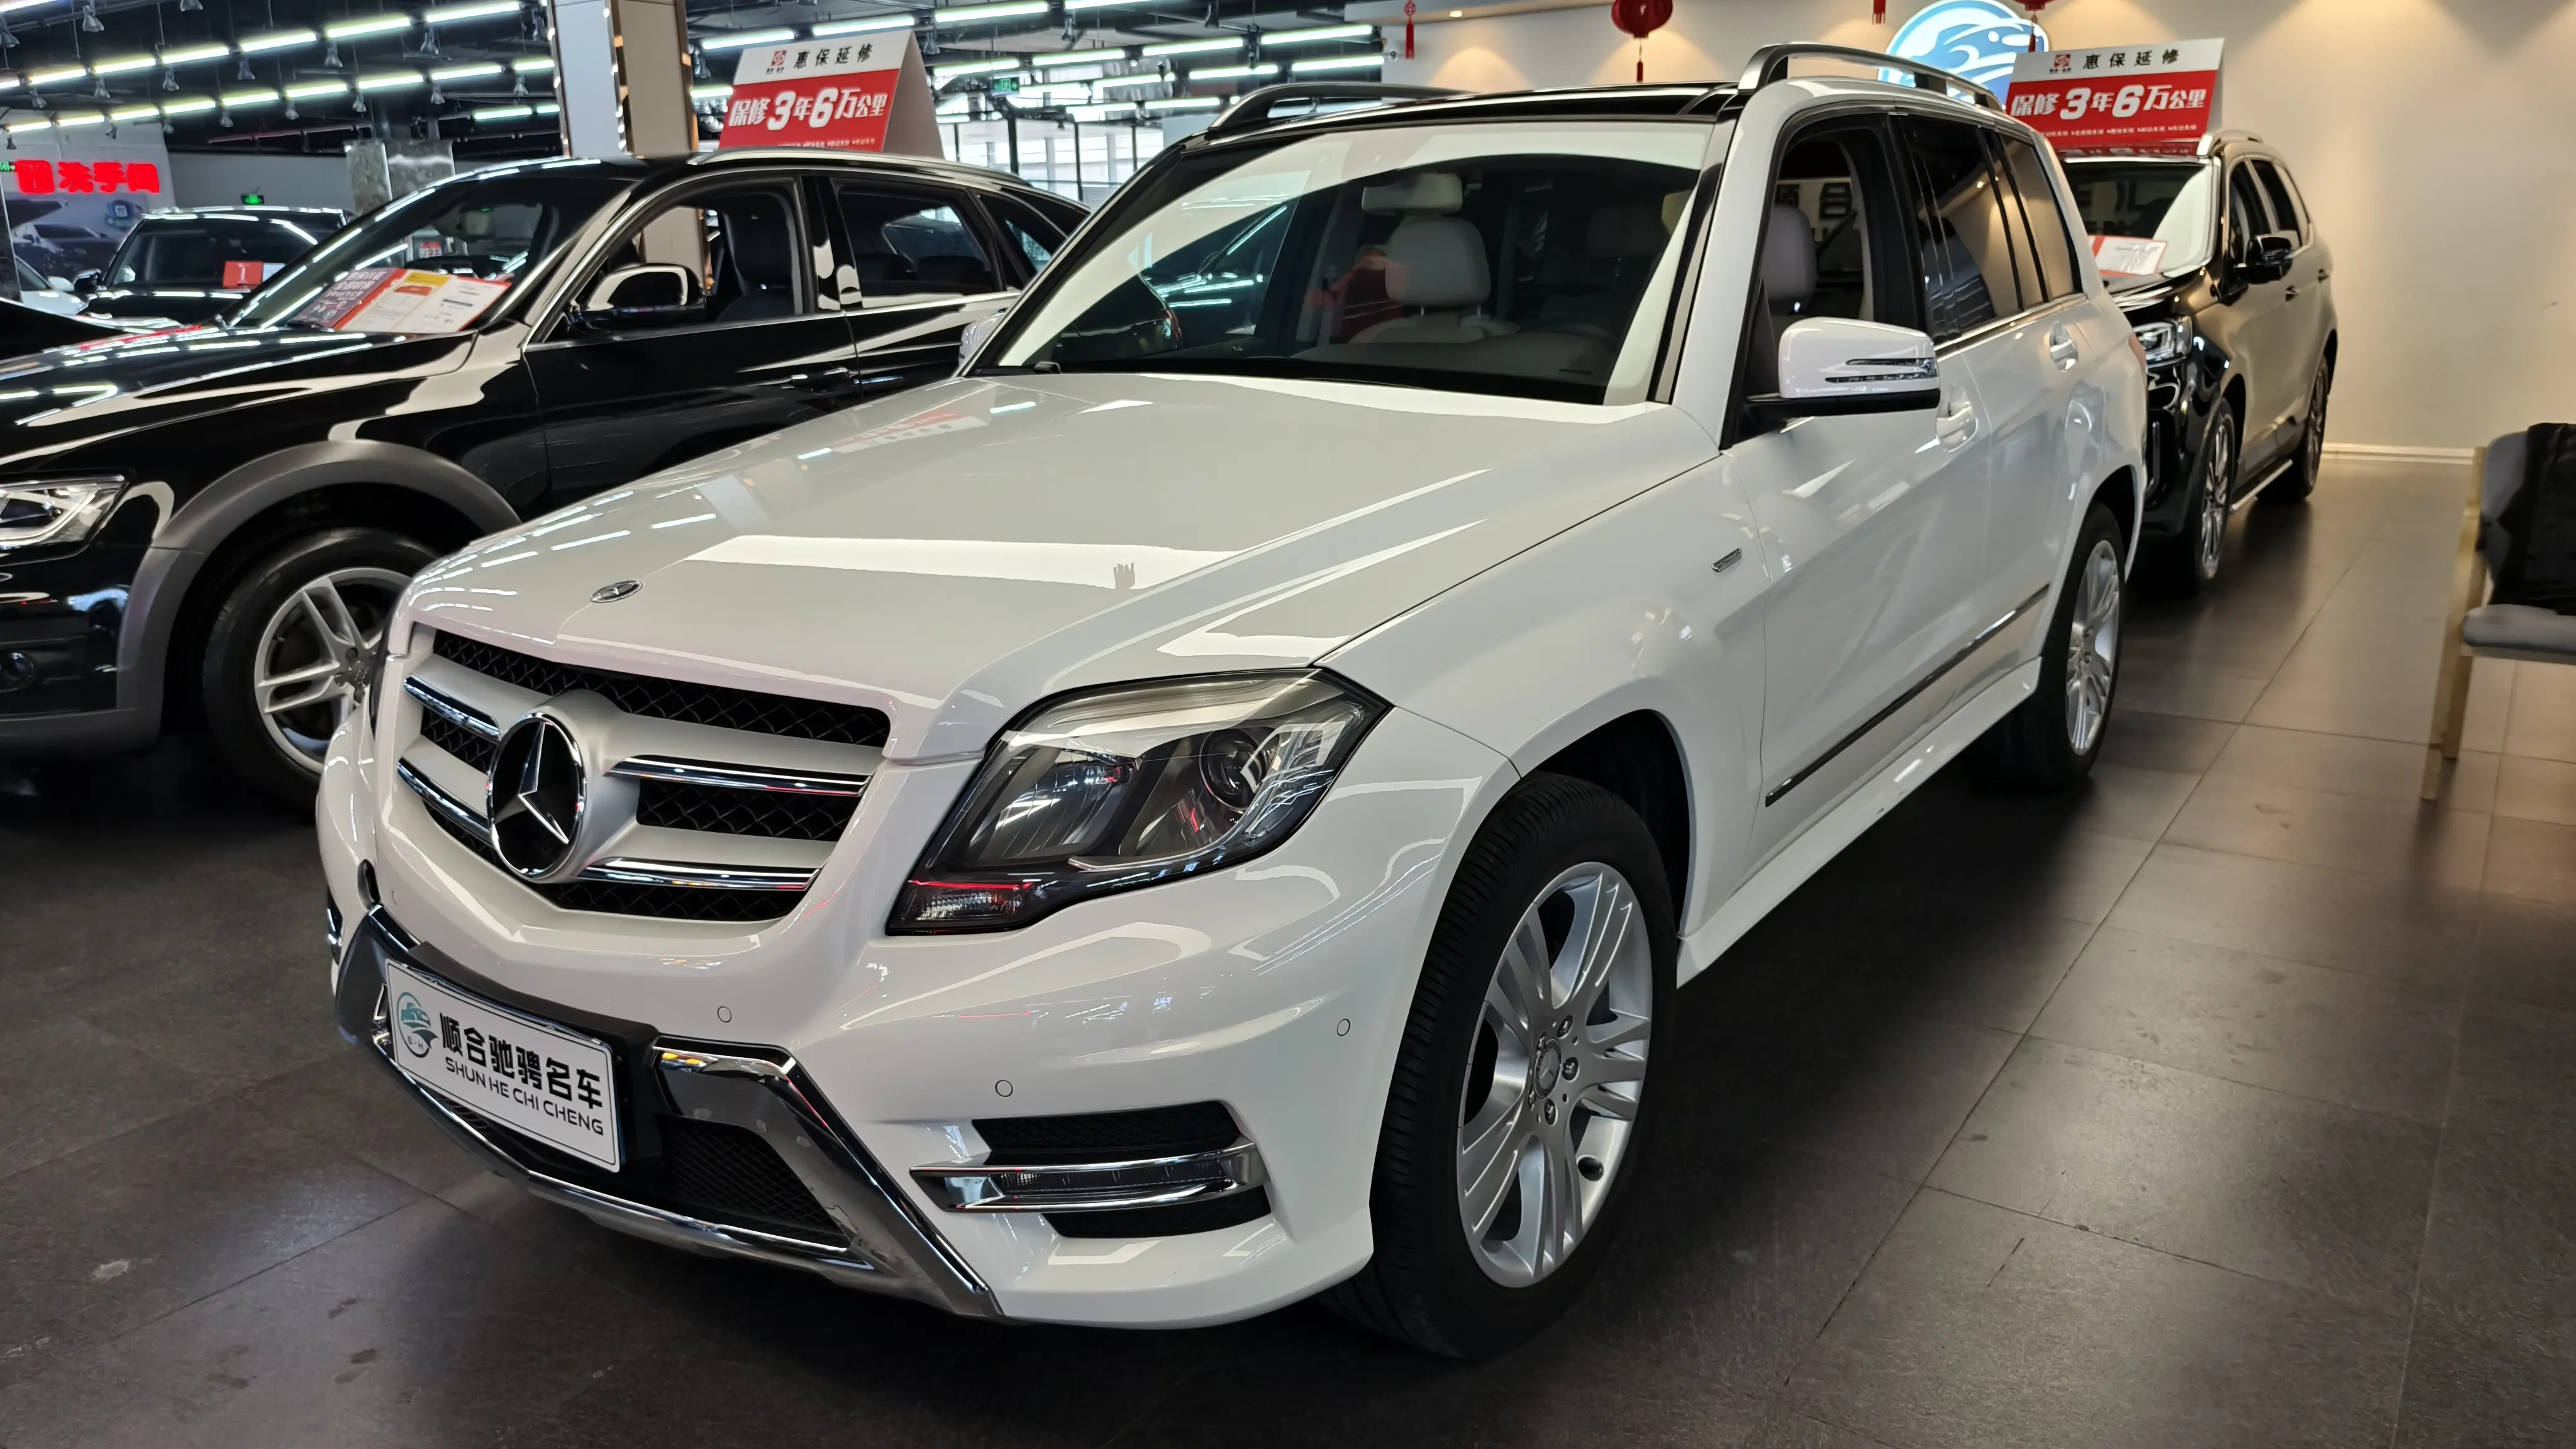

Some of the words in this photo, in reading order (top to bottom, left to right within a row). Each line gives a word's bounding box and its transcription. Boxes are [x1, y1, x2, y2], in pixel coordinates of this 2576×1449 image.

[794, 43, 874, 69] 惠保延修
[2082, 48, 2180, 70] 惠保延修
[728, 87, 888, 131] 保修3年6万公里
[2011, 85, 2207, 120] 保修3年6万公里
[58, 161, 160, 194] 洗手间
[440, 1011, 603, 1109] 顺合驰骋名车
[446, 1058, 486, 1087] SHUN
[489, 1076, 509, 1097] HE
[513, 1086, 540, 1111] CHI
[543, 1101, 604, 1136] CHENG
